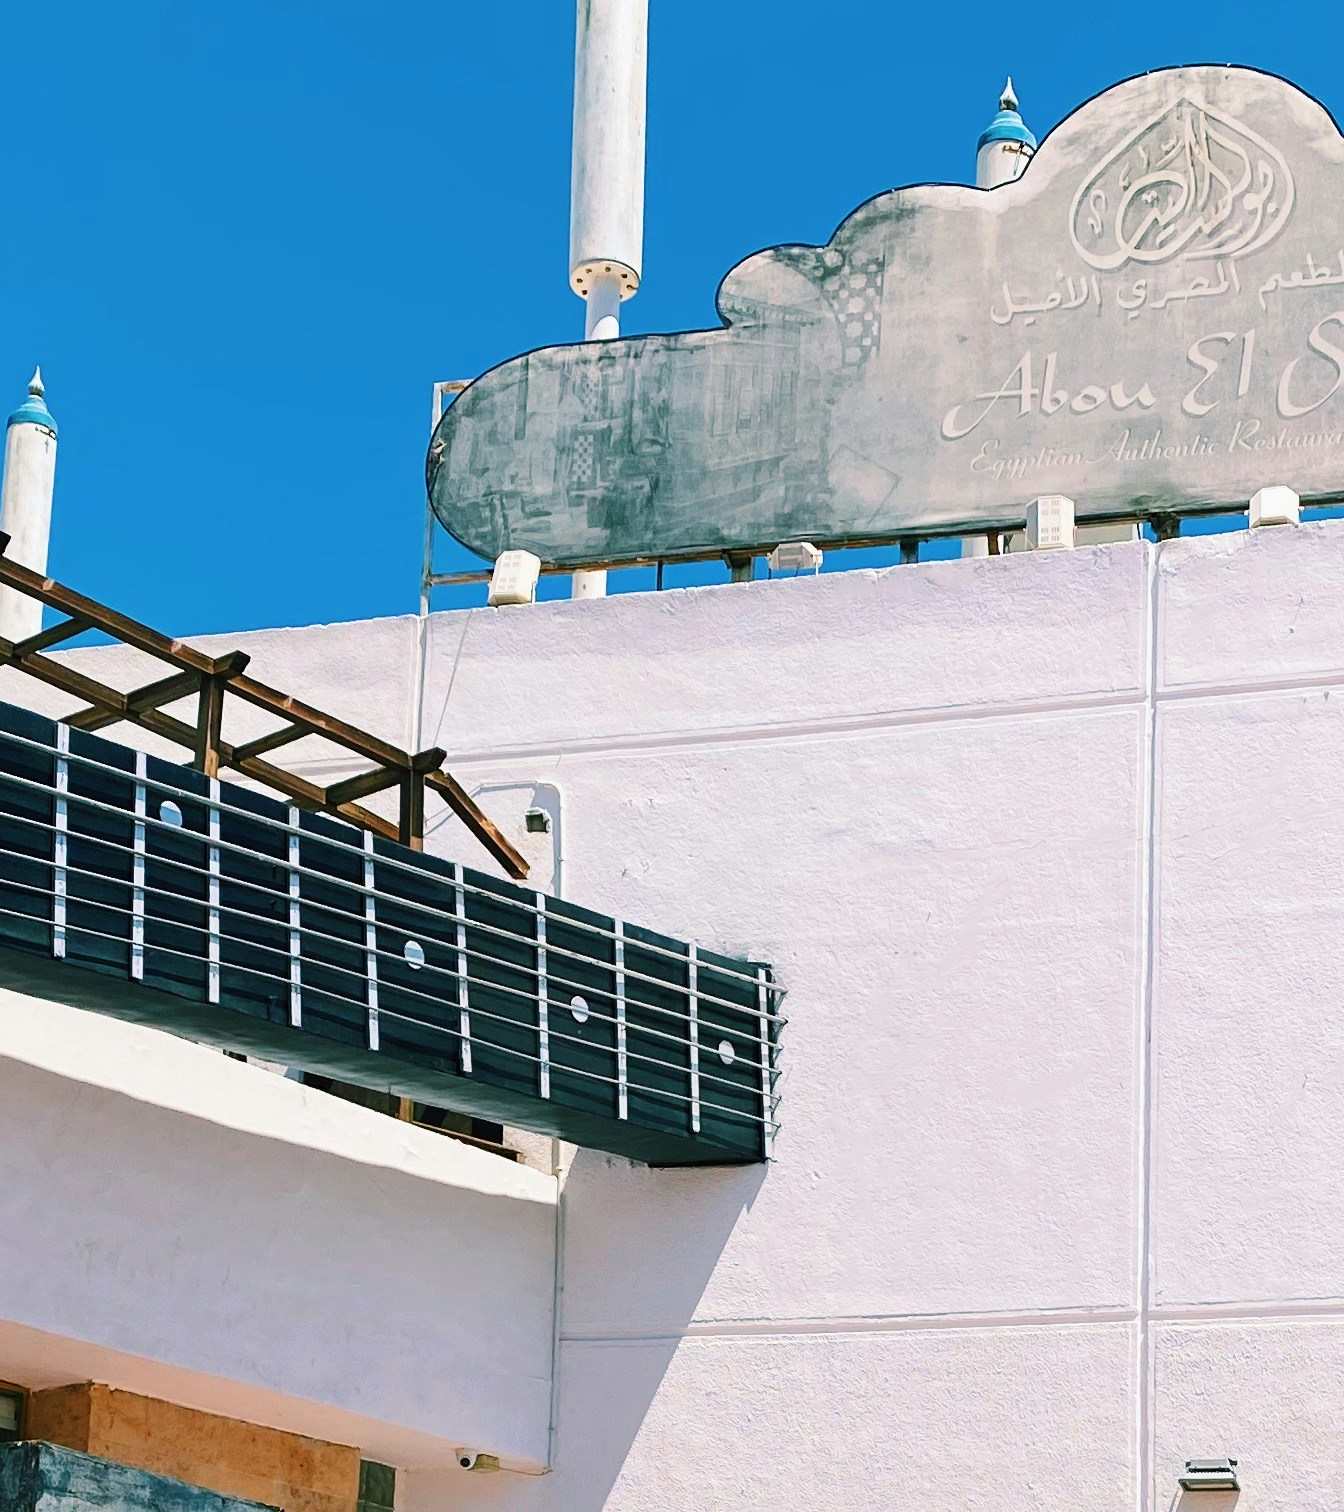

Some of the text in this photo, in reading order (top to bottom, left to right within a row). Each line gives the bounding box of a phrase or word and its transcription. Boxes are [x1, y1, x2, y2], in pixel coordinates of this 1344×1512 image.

[1116, 259, 1243, 320] المصري
[940, 350, 1158, 441] Abou
[1180, 328, 1258, 417] El
[968, 438, 1086, 480] Egyptian
[1083, 427, 1219, 468] Authentic
